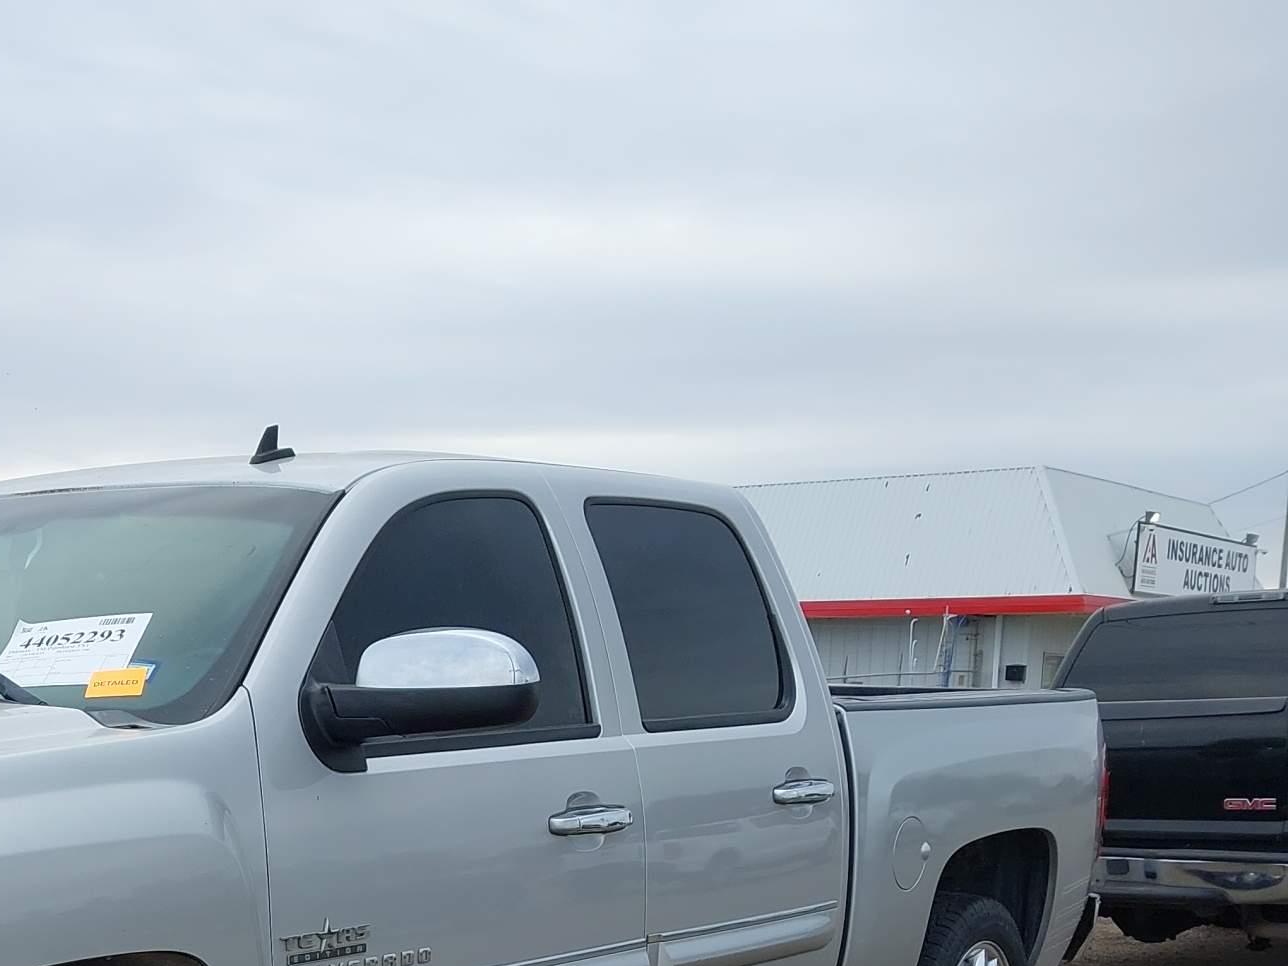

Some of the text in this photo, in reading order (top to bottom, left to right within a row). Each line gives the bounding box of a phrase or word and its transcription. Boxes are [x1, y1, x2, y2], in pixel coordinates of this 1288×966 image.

[1167, 538, 1249, 573] INSURANCE AUTO
[1183, 569, 1231, 593] AUCTIONS
[19, 629, 126, 649] 44052293
[93, 679, 139, 688] DETAILED
[1223, 797, 1277, 810] GMC
[279, 918, 371, 952] TEXAS
[290, 944, 365, 964] EDITION
